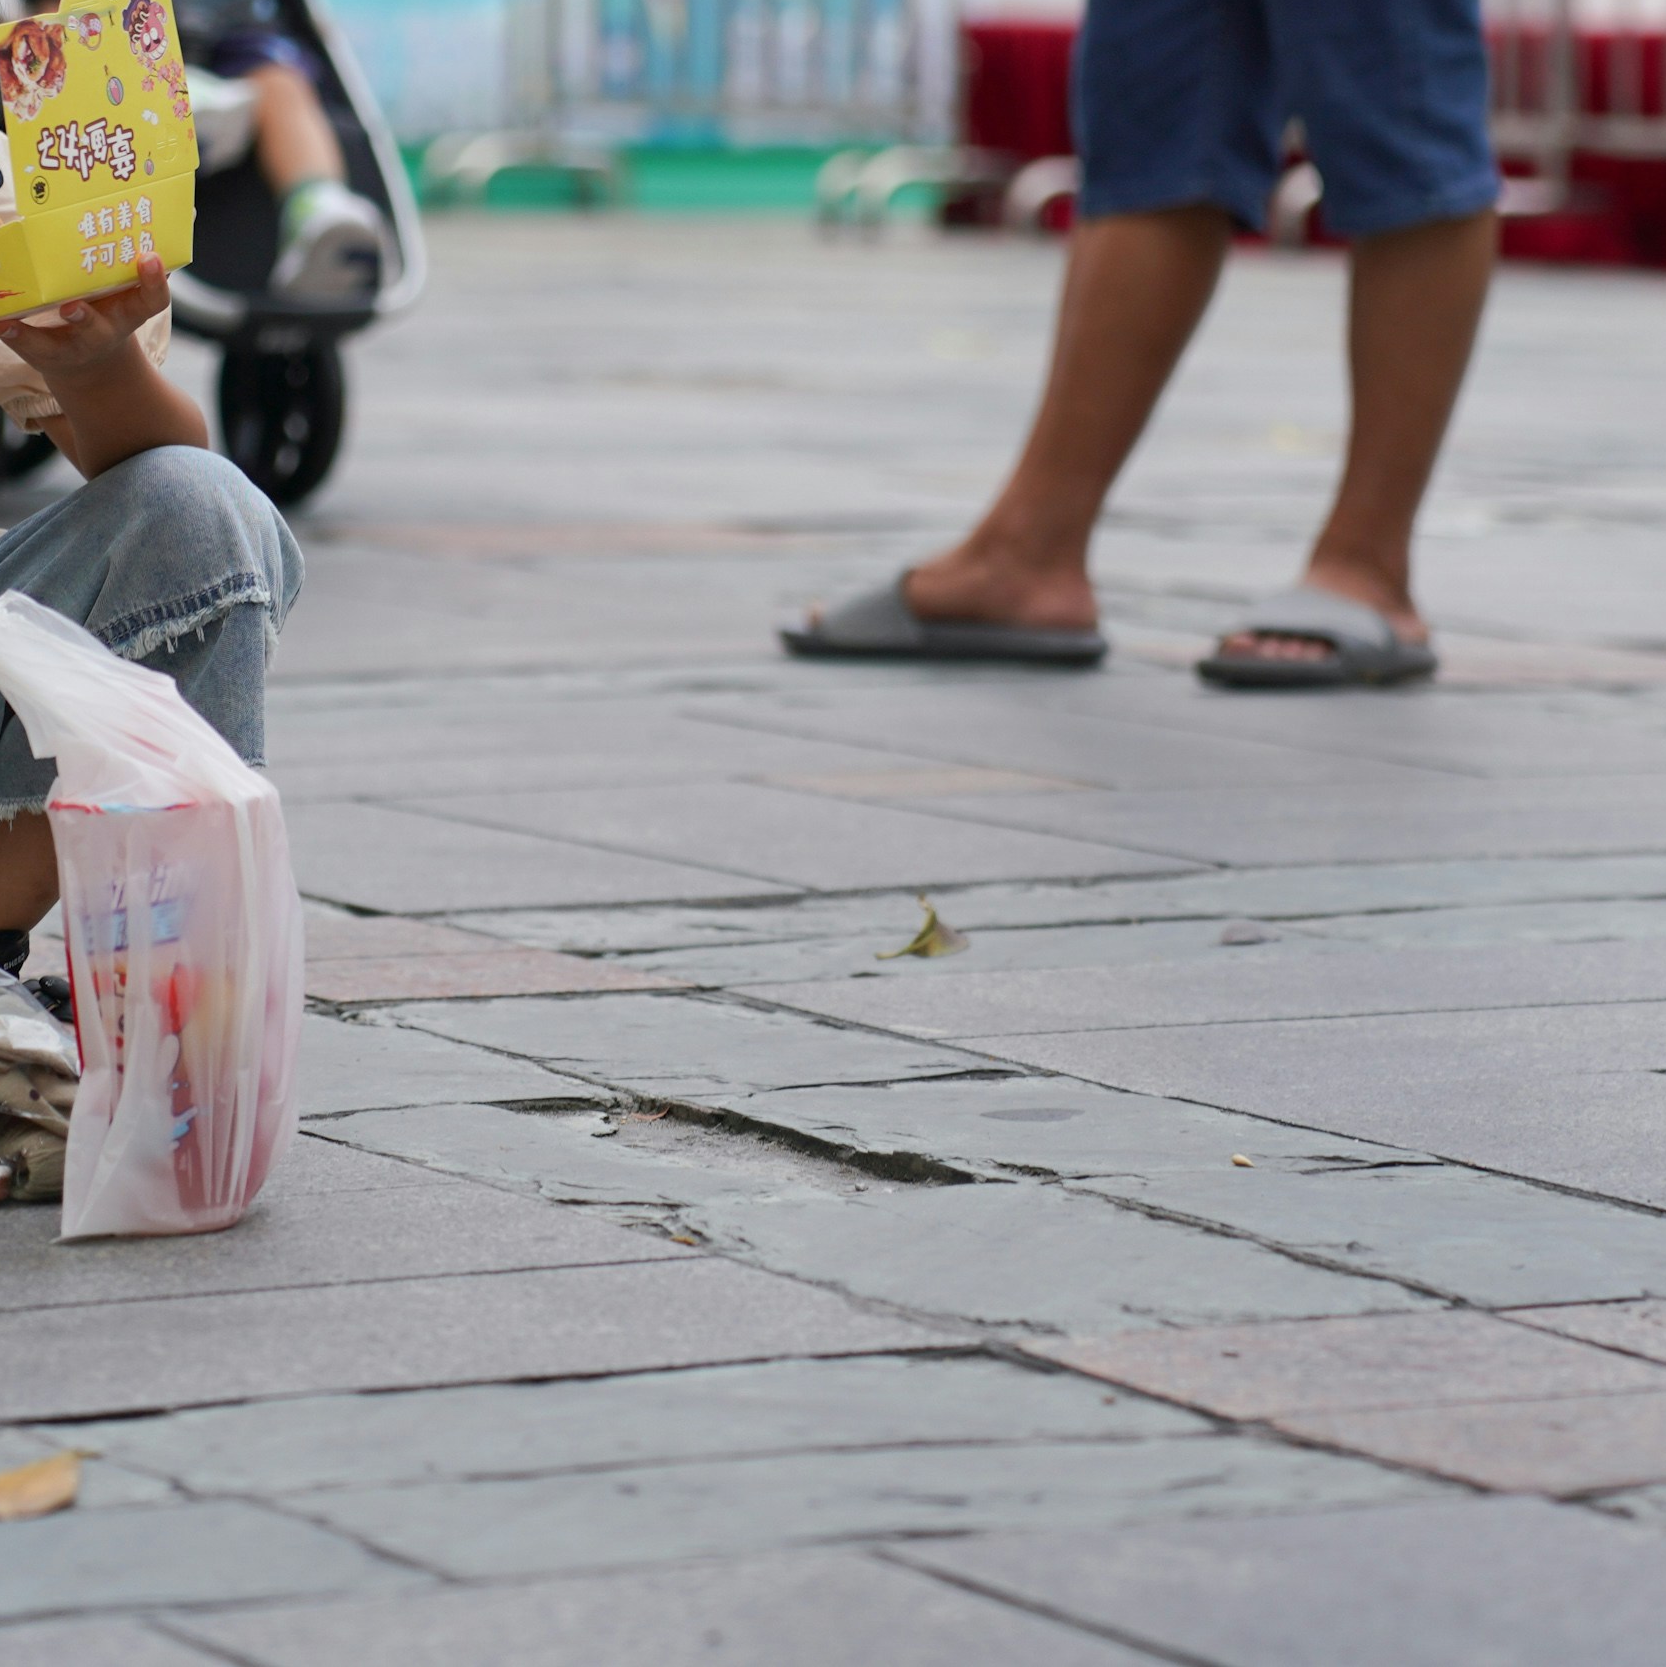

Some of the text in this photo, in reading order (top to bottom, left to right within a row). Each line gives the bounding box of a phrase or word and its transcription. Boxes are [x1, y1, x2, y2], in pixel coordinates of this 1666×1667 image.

[37, 117, 135, 181] 章鱼小丸子
[77, 195, 152, 240] 唯有美食
